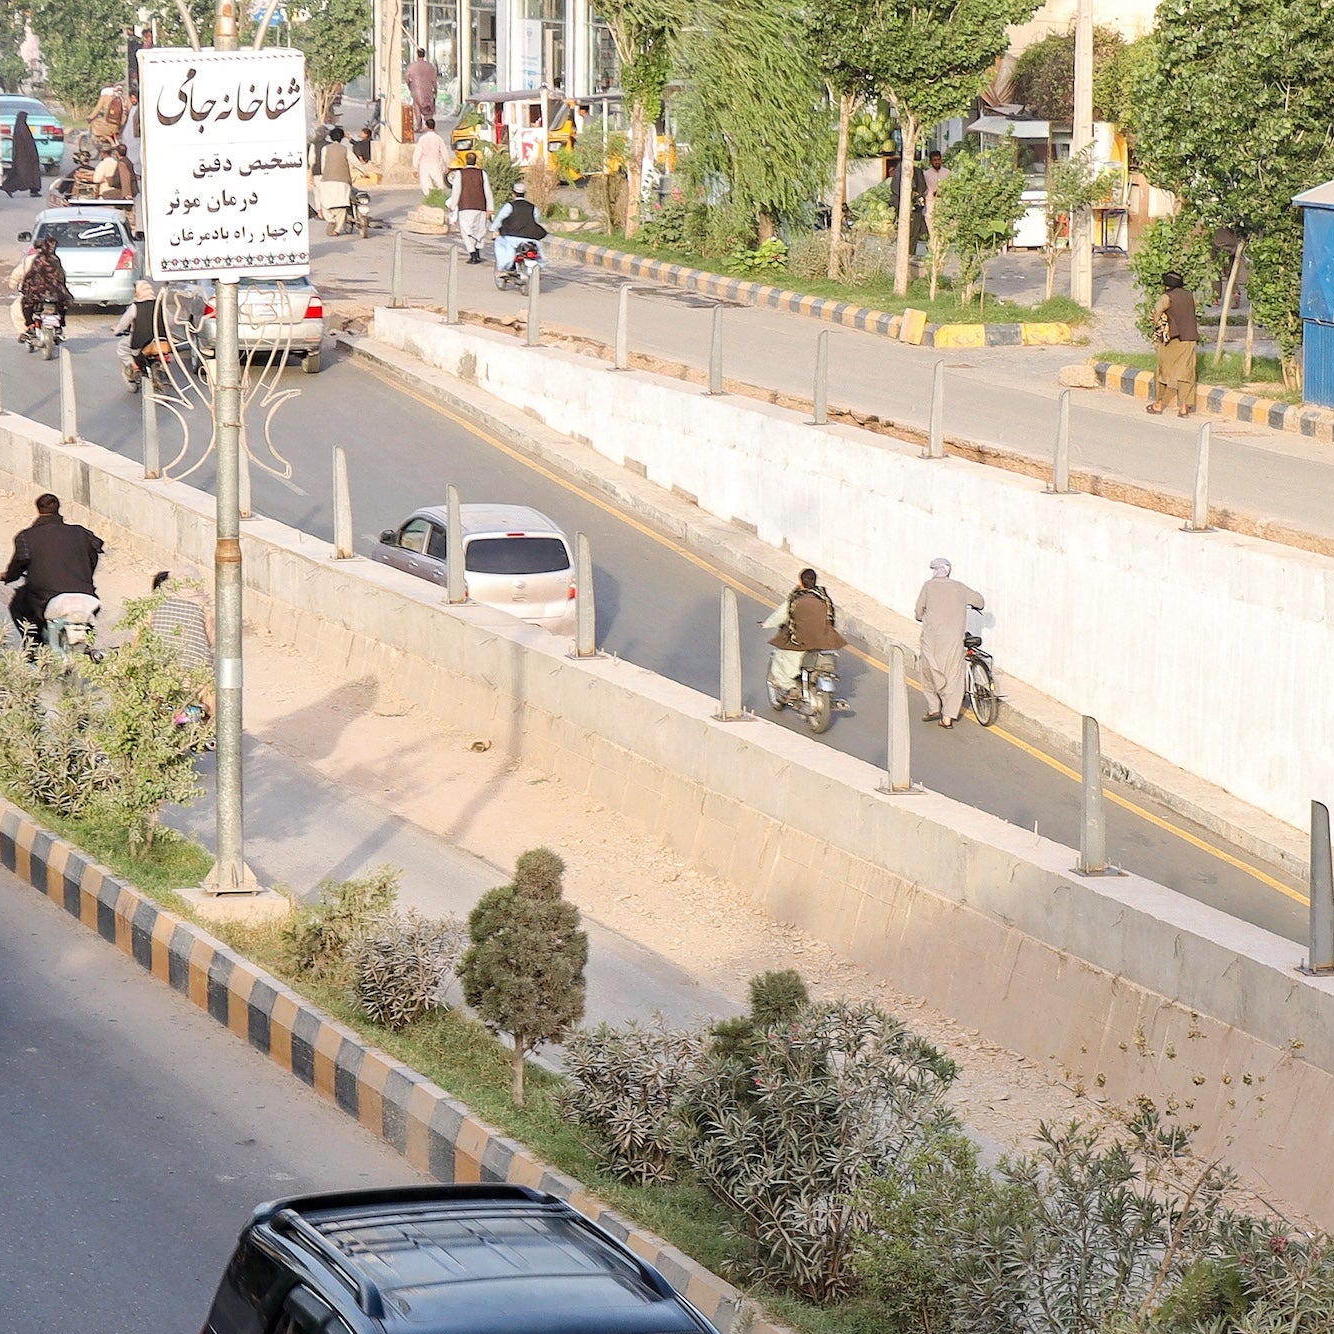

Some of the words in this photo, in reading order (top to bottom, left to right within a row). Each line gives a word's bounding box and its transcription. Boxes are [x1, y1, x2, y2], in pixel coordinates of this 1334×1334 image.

[192, 153, 233, 178] دقیق
[239, 151, 303, 177] تشخیص
[166, 189, 201, 215] موثر
[207, 189, 259, 213] درمان
[234, 225, 254, 243] راه
[259, 224, 288, 242] چهار
